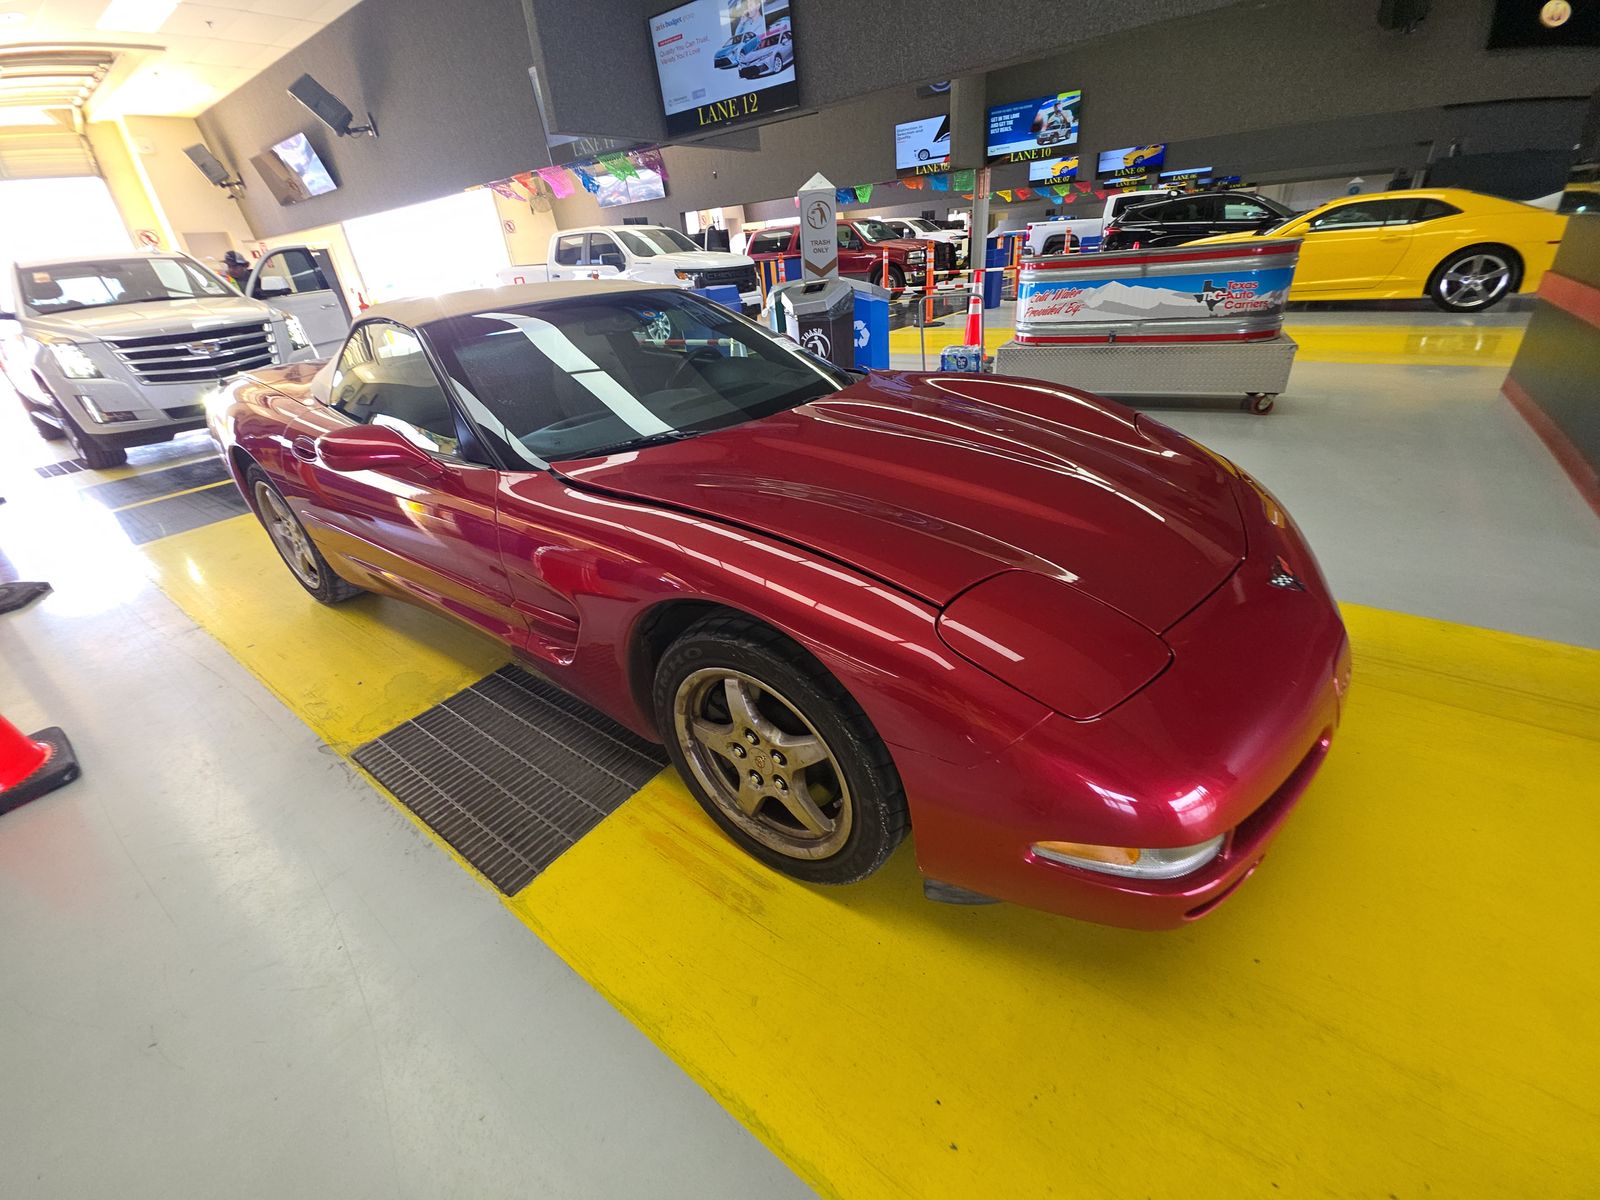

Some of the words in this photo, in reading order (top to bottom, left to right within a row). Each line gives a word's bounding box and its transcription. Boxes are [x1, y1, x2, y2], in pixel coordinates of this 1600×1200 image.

[698, 99, 739, 125] LANE
[742, 93, 758, 114] 12
[572, 137, 603, 156] LANE
[1010, 149, 1038, 162] LANE
[1041, 148, 1052, 158] 10
[916, 164, 940, 175] LANE
[1114, 167, 1135, 177] LANE
[1044, 177, 1063, 185] LANE
[1227, 280, 1259, 290] Texas
[1226, 291, 1255, 300] Auto
[1224, 299, 1270, 310] Carriers
[1024, 303, 1068, 318] Provided
[800, 327, 823, 341] TRASH
